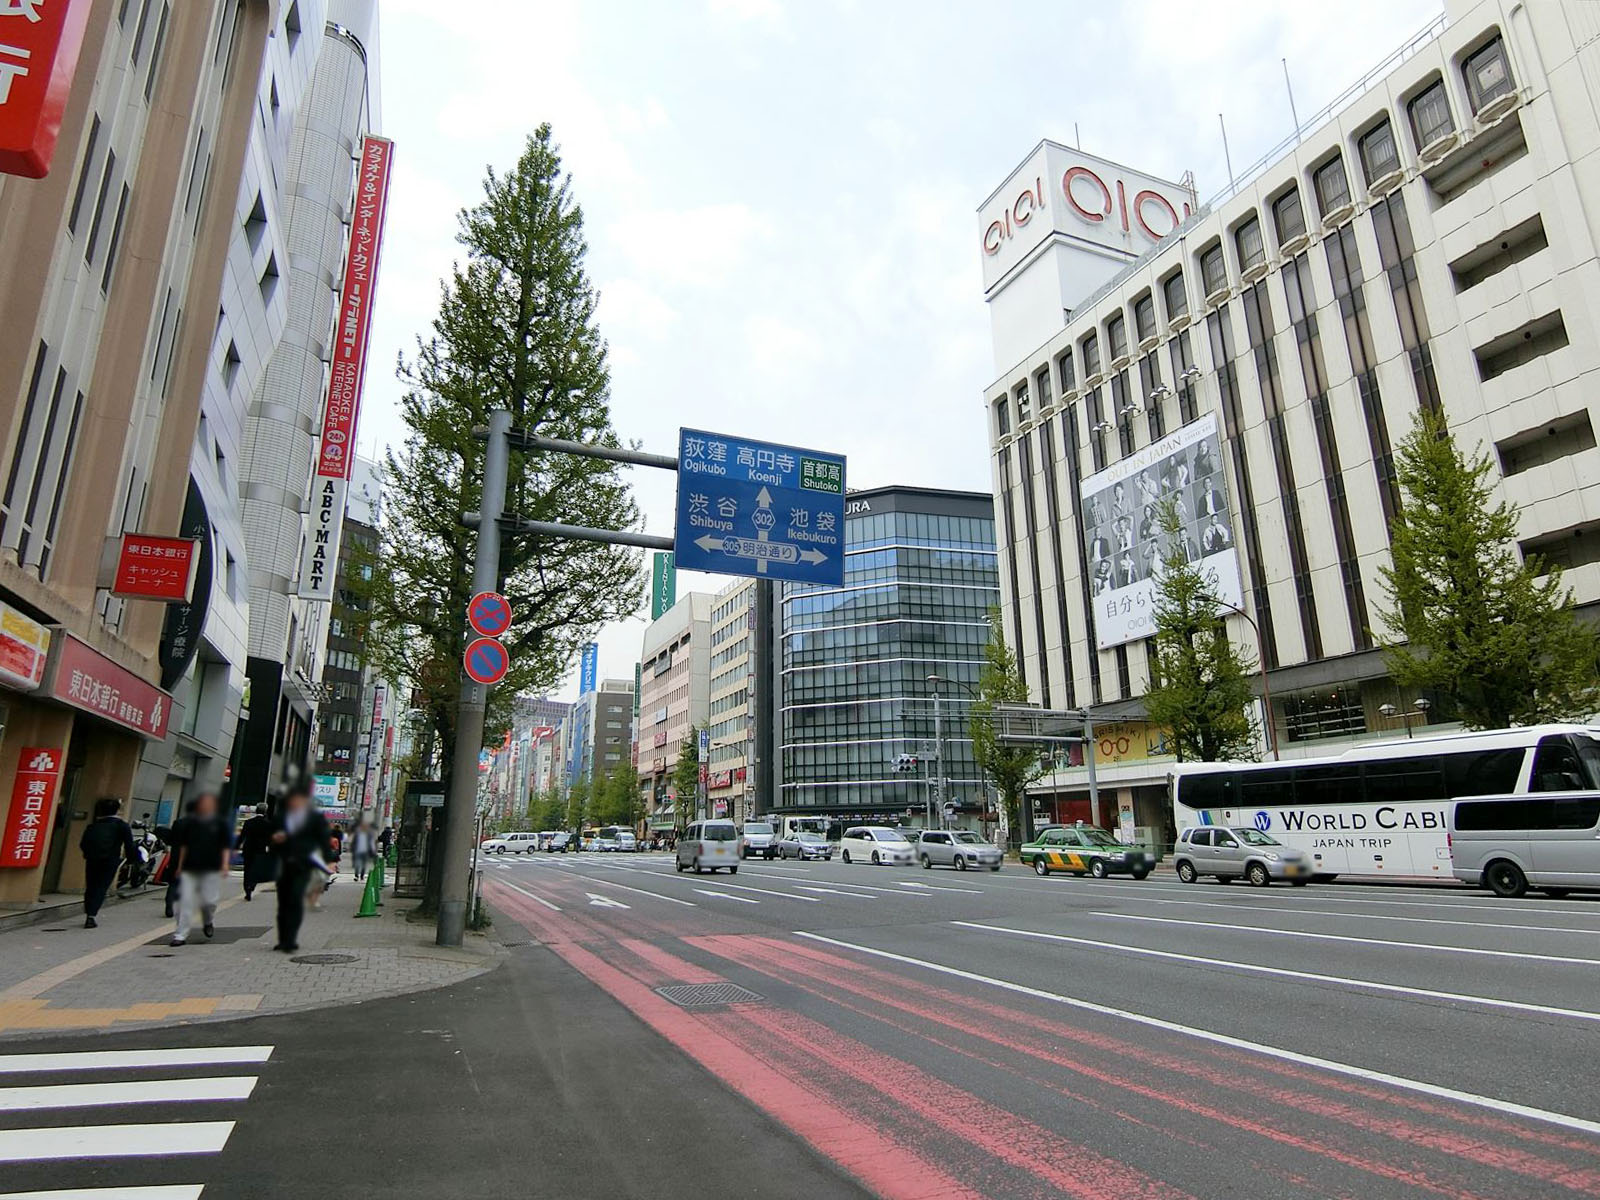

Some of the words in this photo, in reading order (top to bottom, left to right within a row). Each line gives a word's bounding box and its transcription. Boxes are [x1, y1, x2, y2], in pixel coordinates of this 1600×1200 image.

[331, 360, 345, 404] INTERNET
[340, 362, 356, 414] KARAOKE
[328, 406, 340, 428] CAFE
[685, 437, 727, 462] 荻窪
[736, 446, 795, 474] 高円寺
[1107, 462, 1130, 482] OUT
[1133, 454, 1145, 469] IN
[1149, 436, 1182, 463] JAPAN
[684, 459, 727, 476] Ogikubo
[748, 469, 782, 485] Koenji
[803, 461, 840, 482] 首都高
[804, 478, 839, 491] Shutoko
[688, 492, 738, 518] 渋谷
[689, 514, 733, 531] Shibuya
[755, 512, 772, 526] 302
[789, 507, 836, 532] 池袋
[787, 529, 837, 545] Ikebukuro
[127, 544, 188, 559] 東日本銀行
[724, 537, 740, 551] 305
[742, 540, 794, 560] 明治通り
[126, 576, 177, 587] コーナー
[128, 564, 180, 578] キャッシュ
[68, 669, 121, 713] 東日本銀行
[14, 780, 48, 860] 東日本銀行
[1313, 838, 1354, 848] JAPAN
[1359, 838, 1392, 848] TRIP
